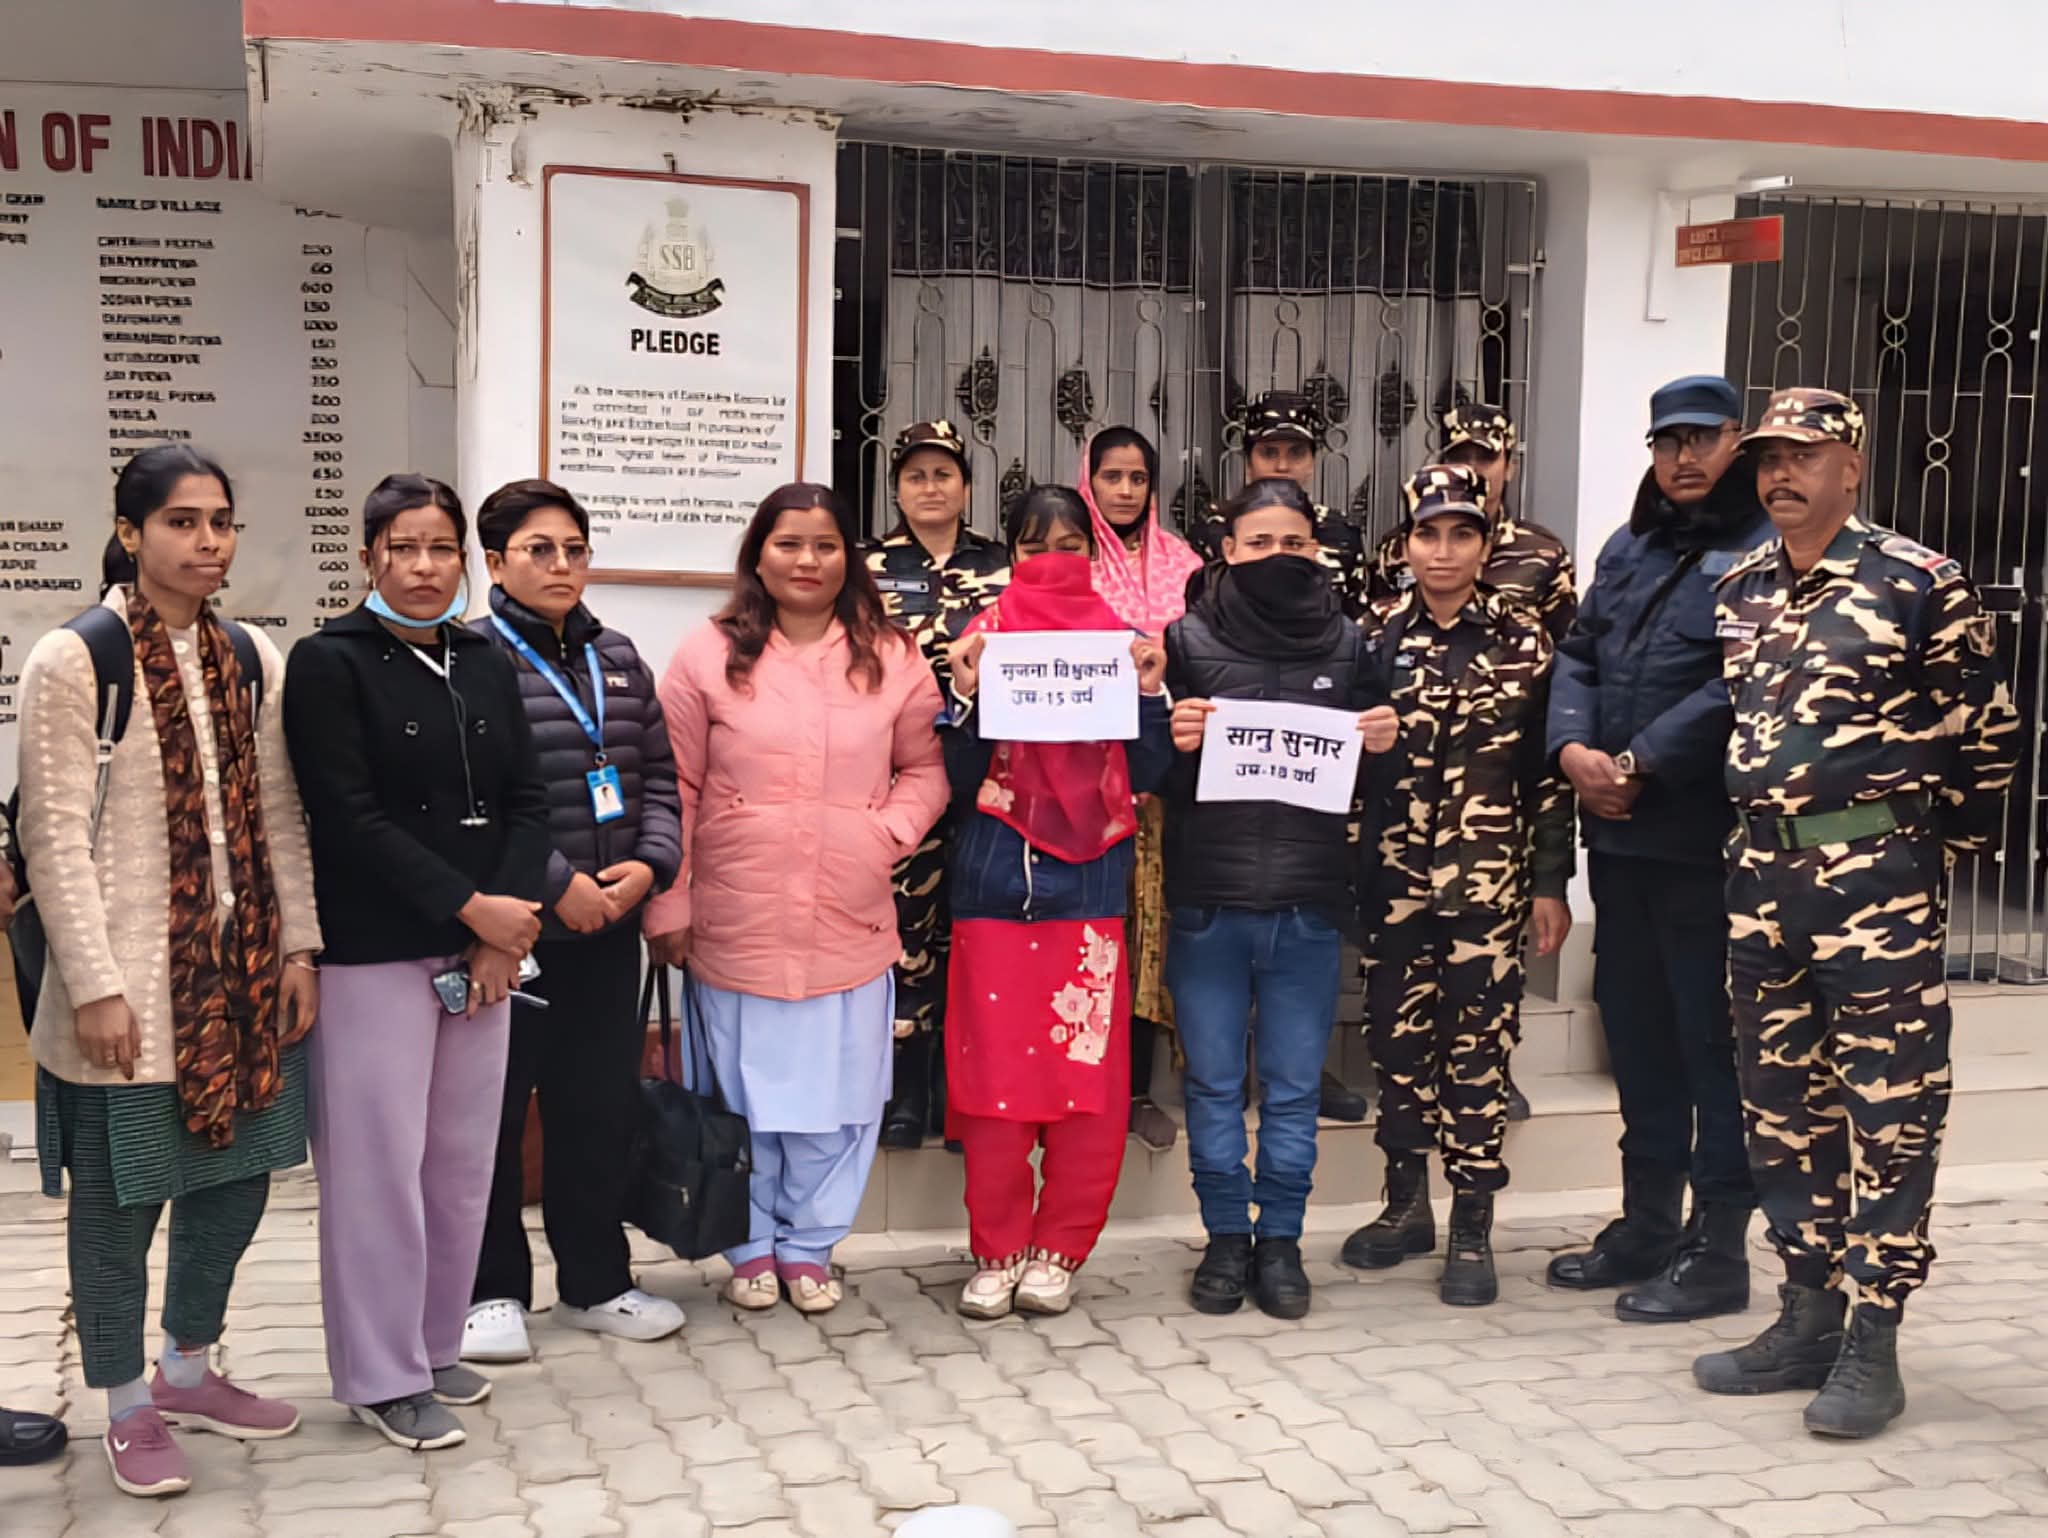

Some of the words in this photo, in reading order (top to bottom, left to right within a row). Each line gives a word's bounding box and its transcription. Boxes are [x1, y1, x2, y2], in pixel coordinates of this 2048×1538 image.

[42, 112, 111, 174] OF
[631, 329, 720, 355] PLEDGE
[1226, 726, 1275, 753] सानु
[1281, 729, 1346, 760] सुनार
